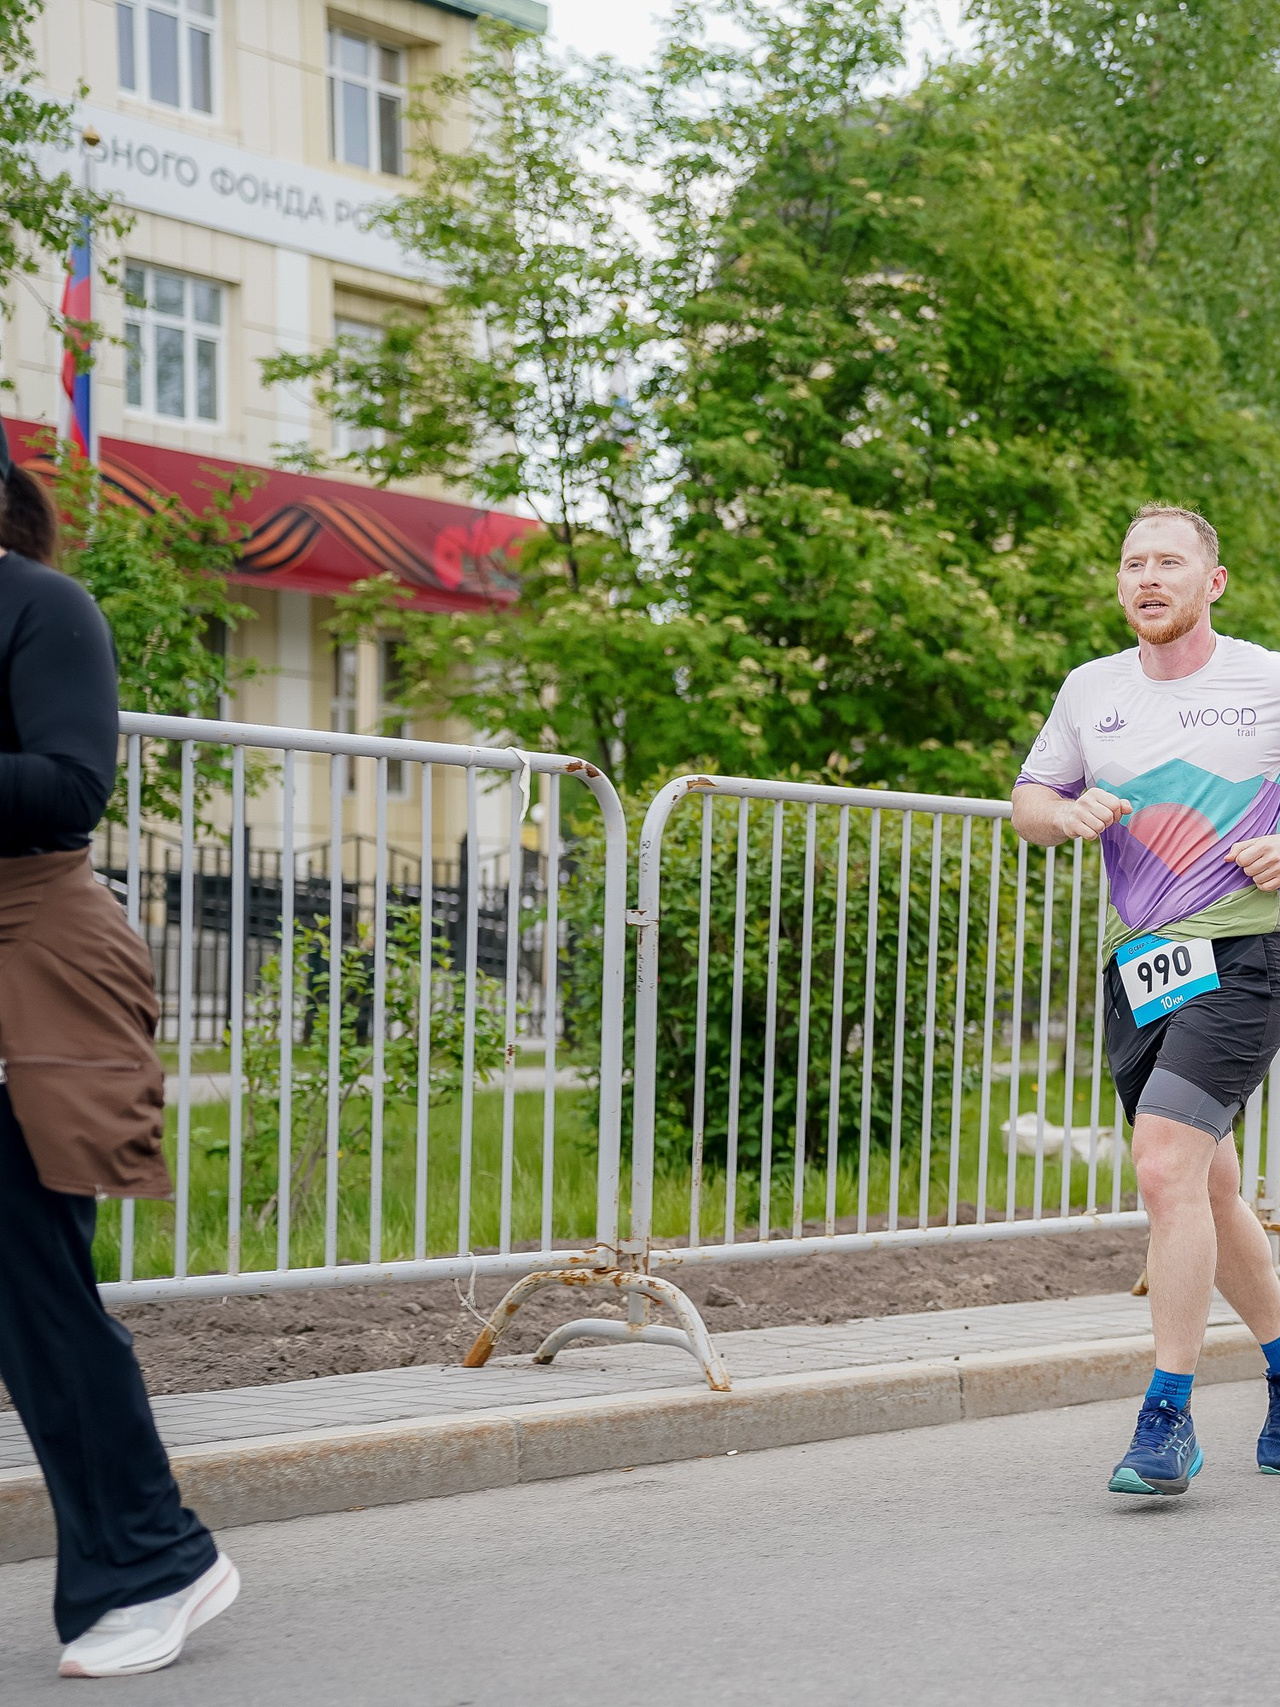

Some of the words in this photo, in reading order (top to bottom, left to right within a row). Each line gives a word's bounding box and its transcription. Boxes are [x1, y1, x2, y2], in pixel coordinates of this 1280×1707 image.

[210, 166, 327, 221] ФОНДА
[1178, 708, 1257, 728] WOOD
[1237, 727, 1256, 737] trail
[1137, 945, 1192, 994] 990
